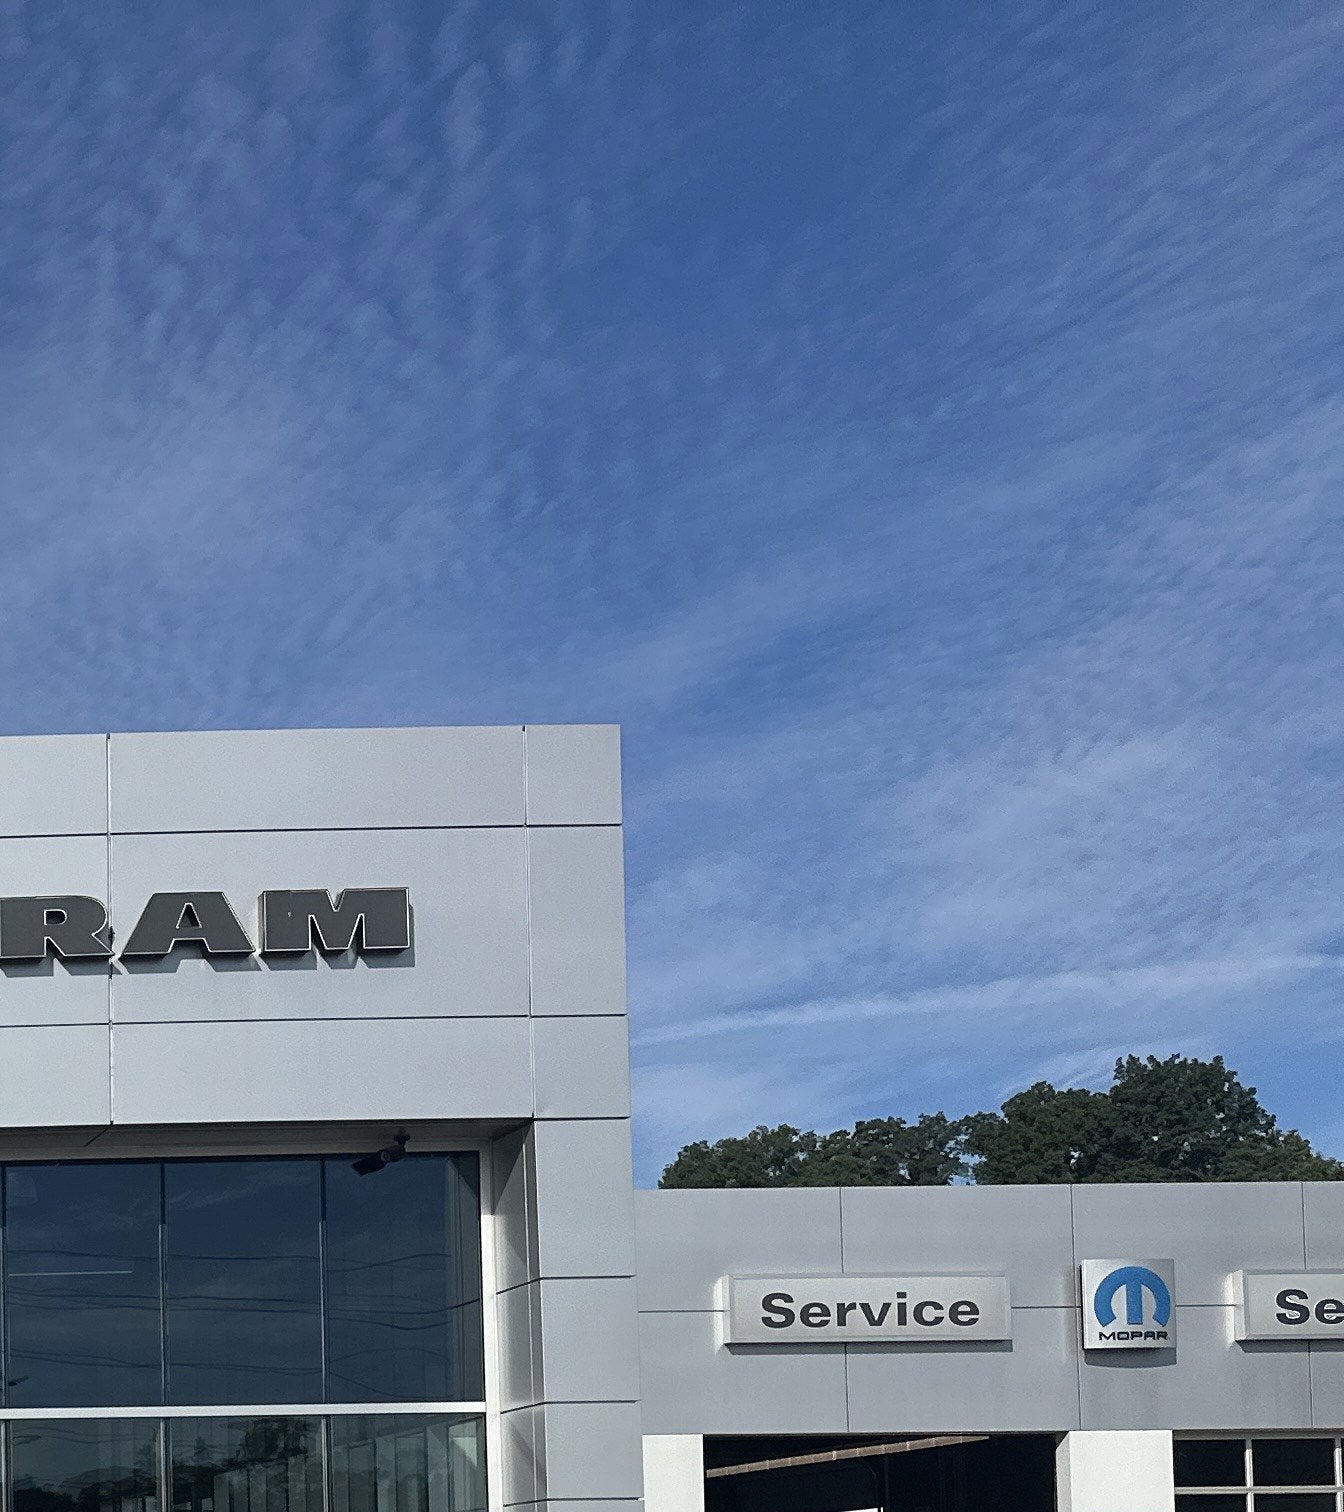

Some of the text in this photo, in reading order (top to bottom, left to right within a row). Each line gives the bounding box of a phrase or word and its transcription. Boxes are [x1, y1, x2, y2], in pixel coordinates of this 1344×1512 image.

[760, 1291, 981, 1330] Service
[1275, 1288, 1344, 1326] Se
[1098, 1331, 1169, 1341] MOPAR
